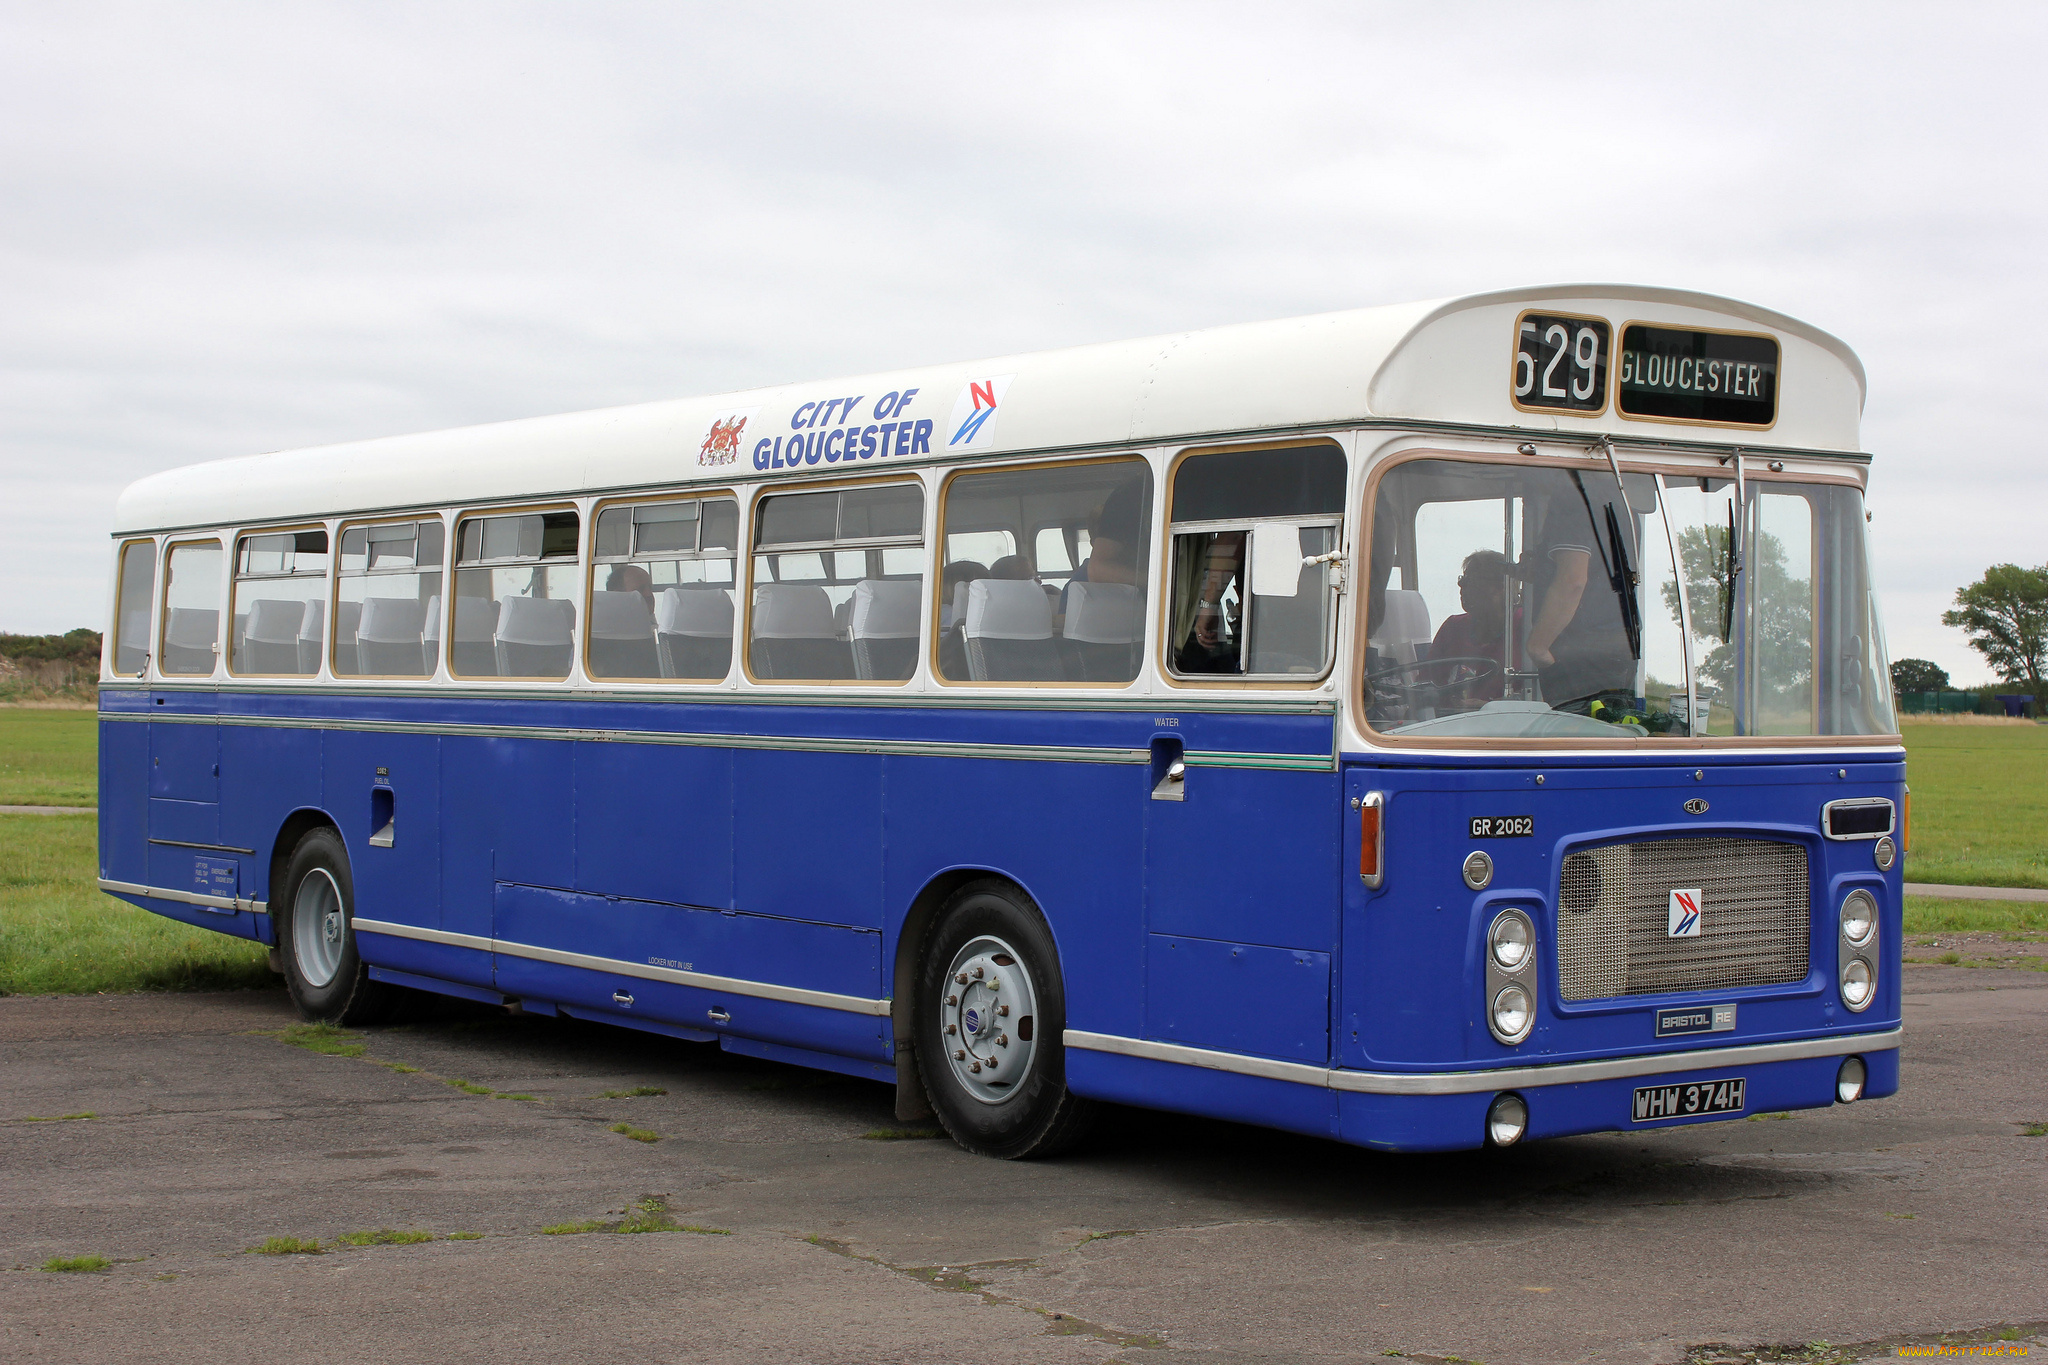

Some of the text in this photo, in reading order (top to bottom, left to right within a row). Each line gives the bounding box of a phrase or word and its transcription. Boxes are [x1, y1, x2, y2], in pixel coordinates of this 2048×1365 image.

[1620, 349, 1761, 397] GLOUCESTER
[790, 388, 920, 430] CITY OF
[752, 418, 933, 471] GLOUCESTER
[1154, 717, 1179, 727] WATER
[1687, 800, 1708, 812] ECW
[1472, 818, 1532, 835] GR 2062
[648, 956, 693, 970] LOCKER NOT IN USE
[1662, 1011, 1731, 1029] BRISTOL RE
[1635, 1081, 1744, 1118] WHW 374H
